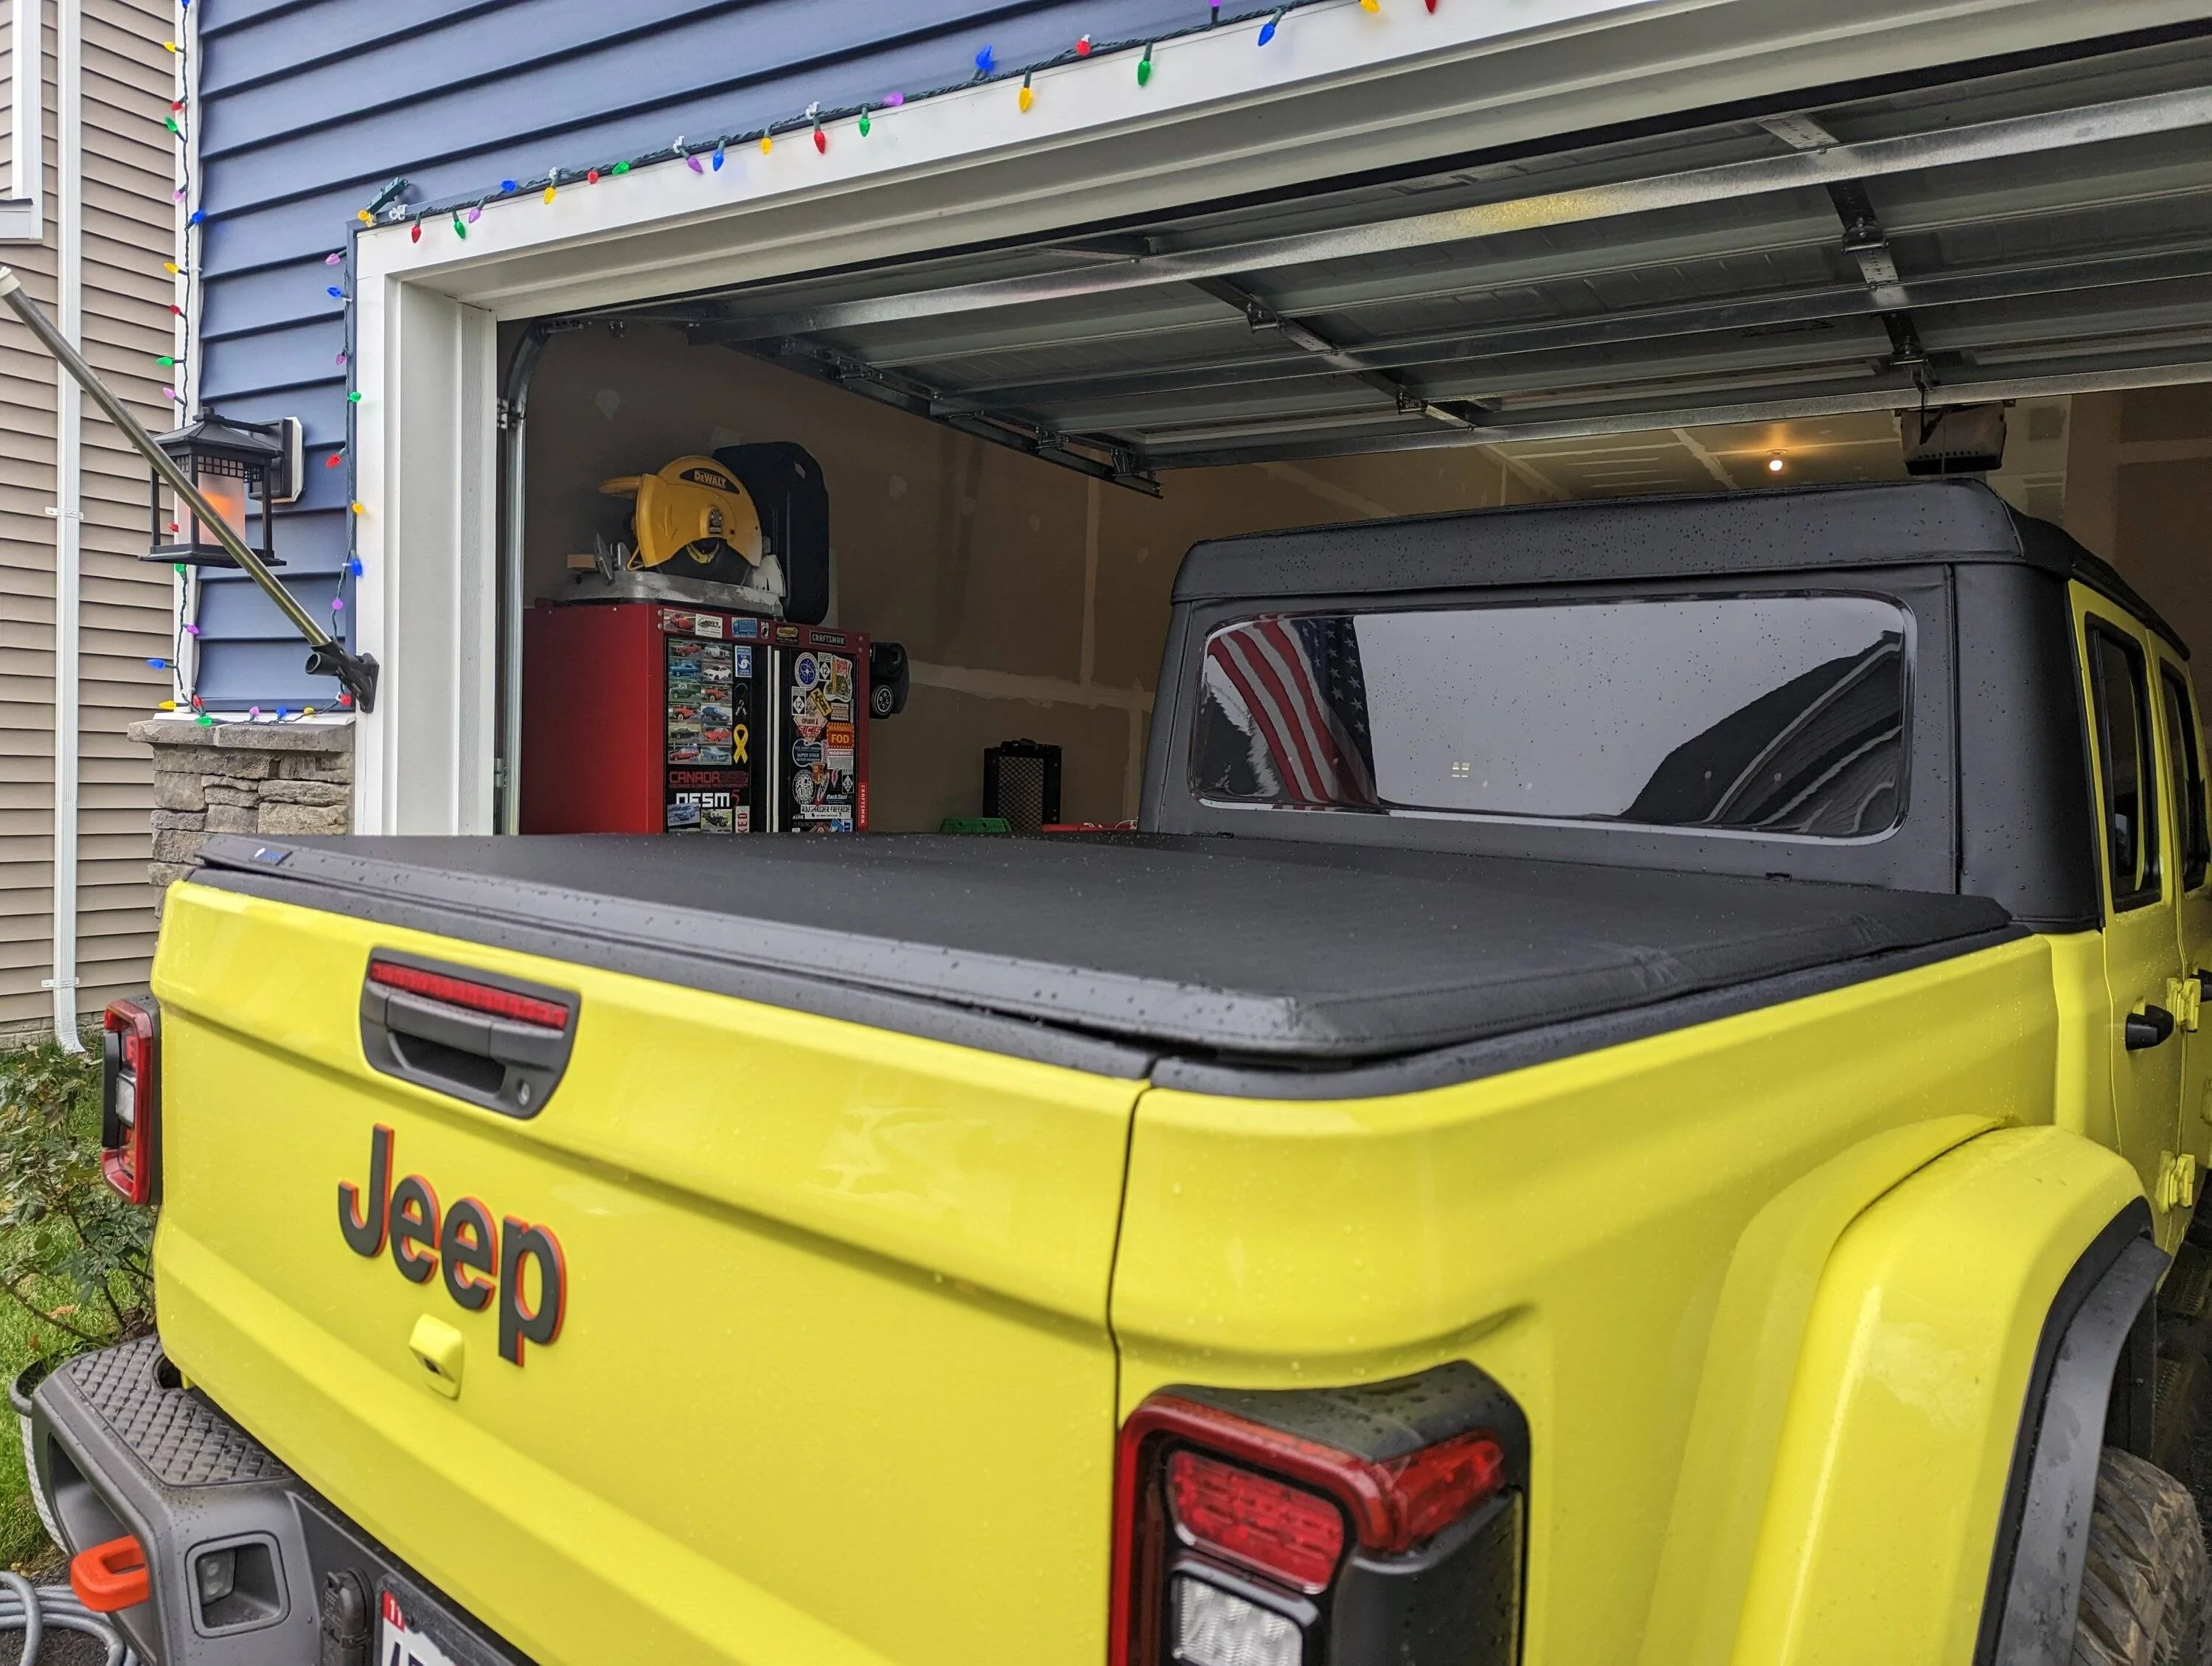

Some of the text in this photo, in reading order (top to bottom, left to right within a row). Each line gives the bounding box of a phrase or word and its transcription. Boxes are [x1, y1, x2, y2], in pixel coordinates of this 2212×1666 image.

[812, 632, 845, 645] CRAFTSMAN
[822, 667, 828, 676] 12
[796, 700, 802, 709] 12
[831, 734, 849, 743] FOD
[669, 771, 720, 784] CANADA
[338, 1122, 567, 1368] Jeep
